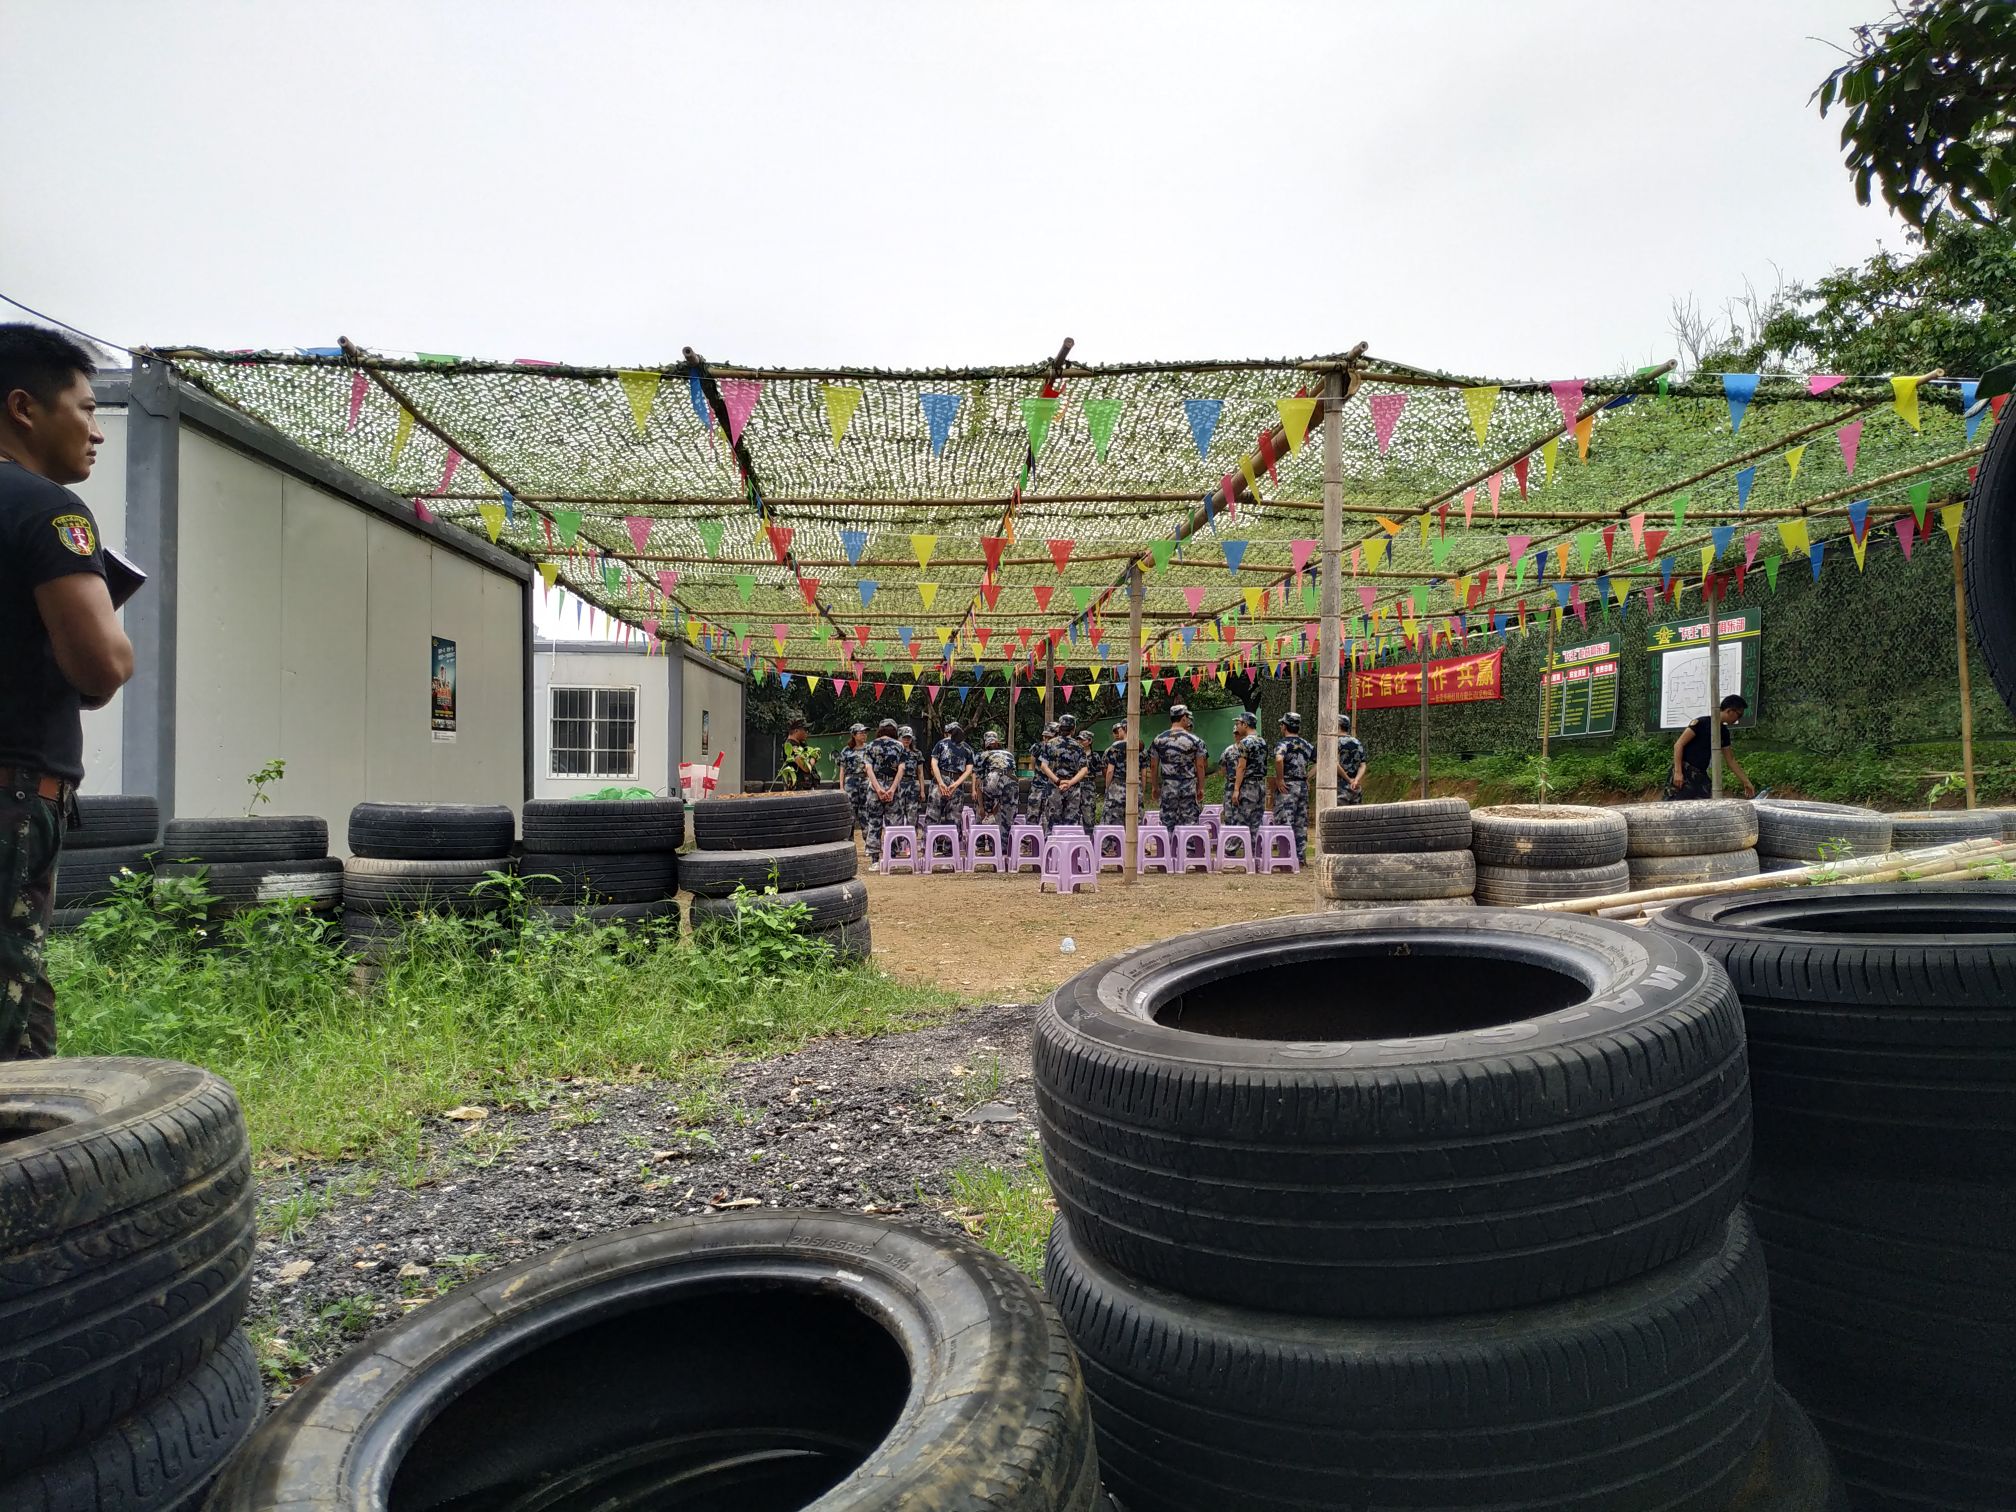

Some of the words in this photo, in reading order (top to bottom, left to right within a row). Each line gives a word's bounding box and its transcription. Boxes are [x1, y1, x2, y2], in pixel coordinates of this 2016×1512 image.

[1379, 671, 1408, 697] 信任
[1457, 659, 1495, 688] 共赢
[1278, 964, 1688, 1060] MA-656
